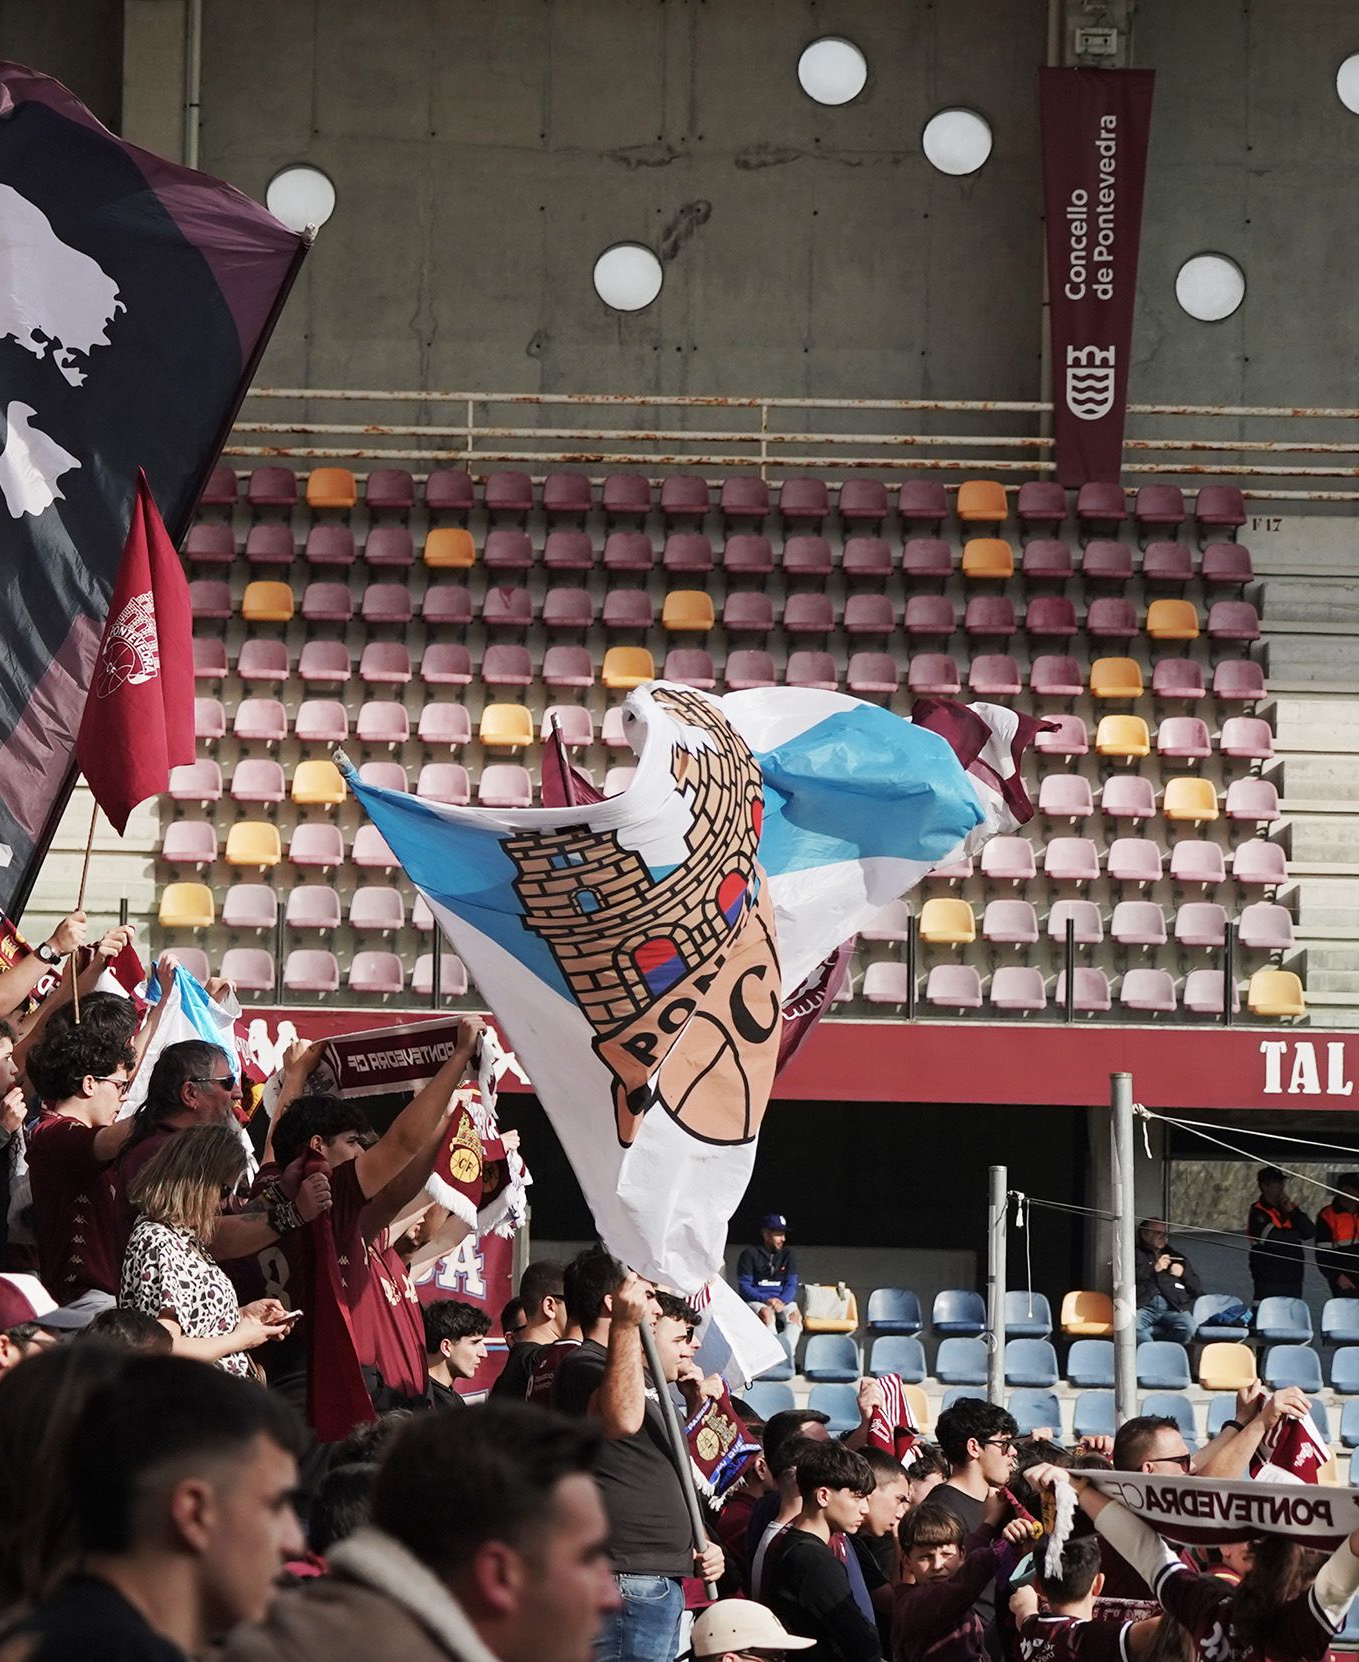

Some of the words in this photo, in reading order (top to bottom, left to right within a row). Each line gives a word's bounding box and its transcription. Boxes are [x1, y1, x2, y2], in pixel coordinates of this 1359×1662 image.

[1093, 114, 1118, 262] Pontevedra
[1064, 188, 1089, 300] Concello
[1092, 267, 1114, 300] de
[1266, 518, 1283, 532] 17
